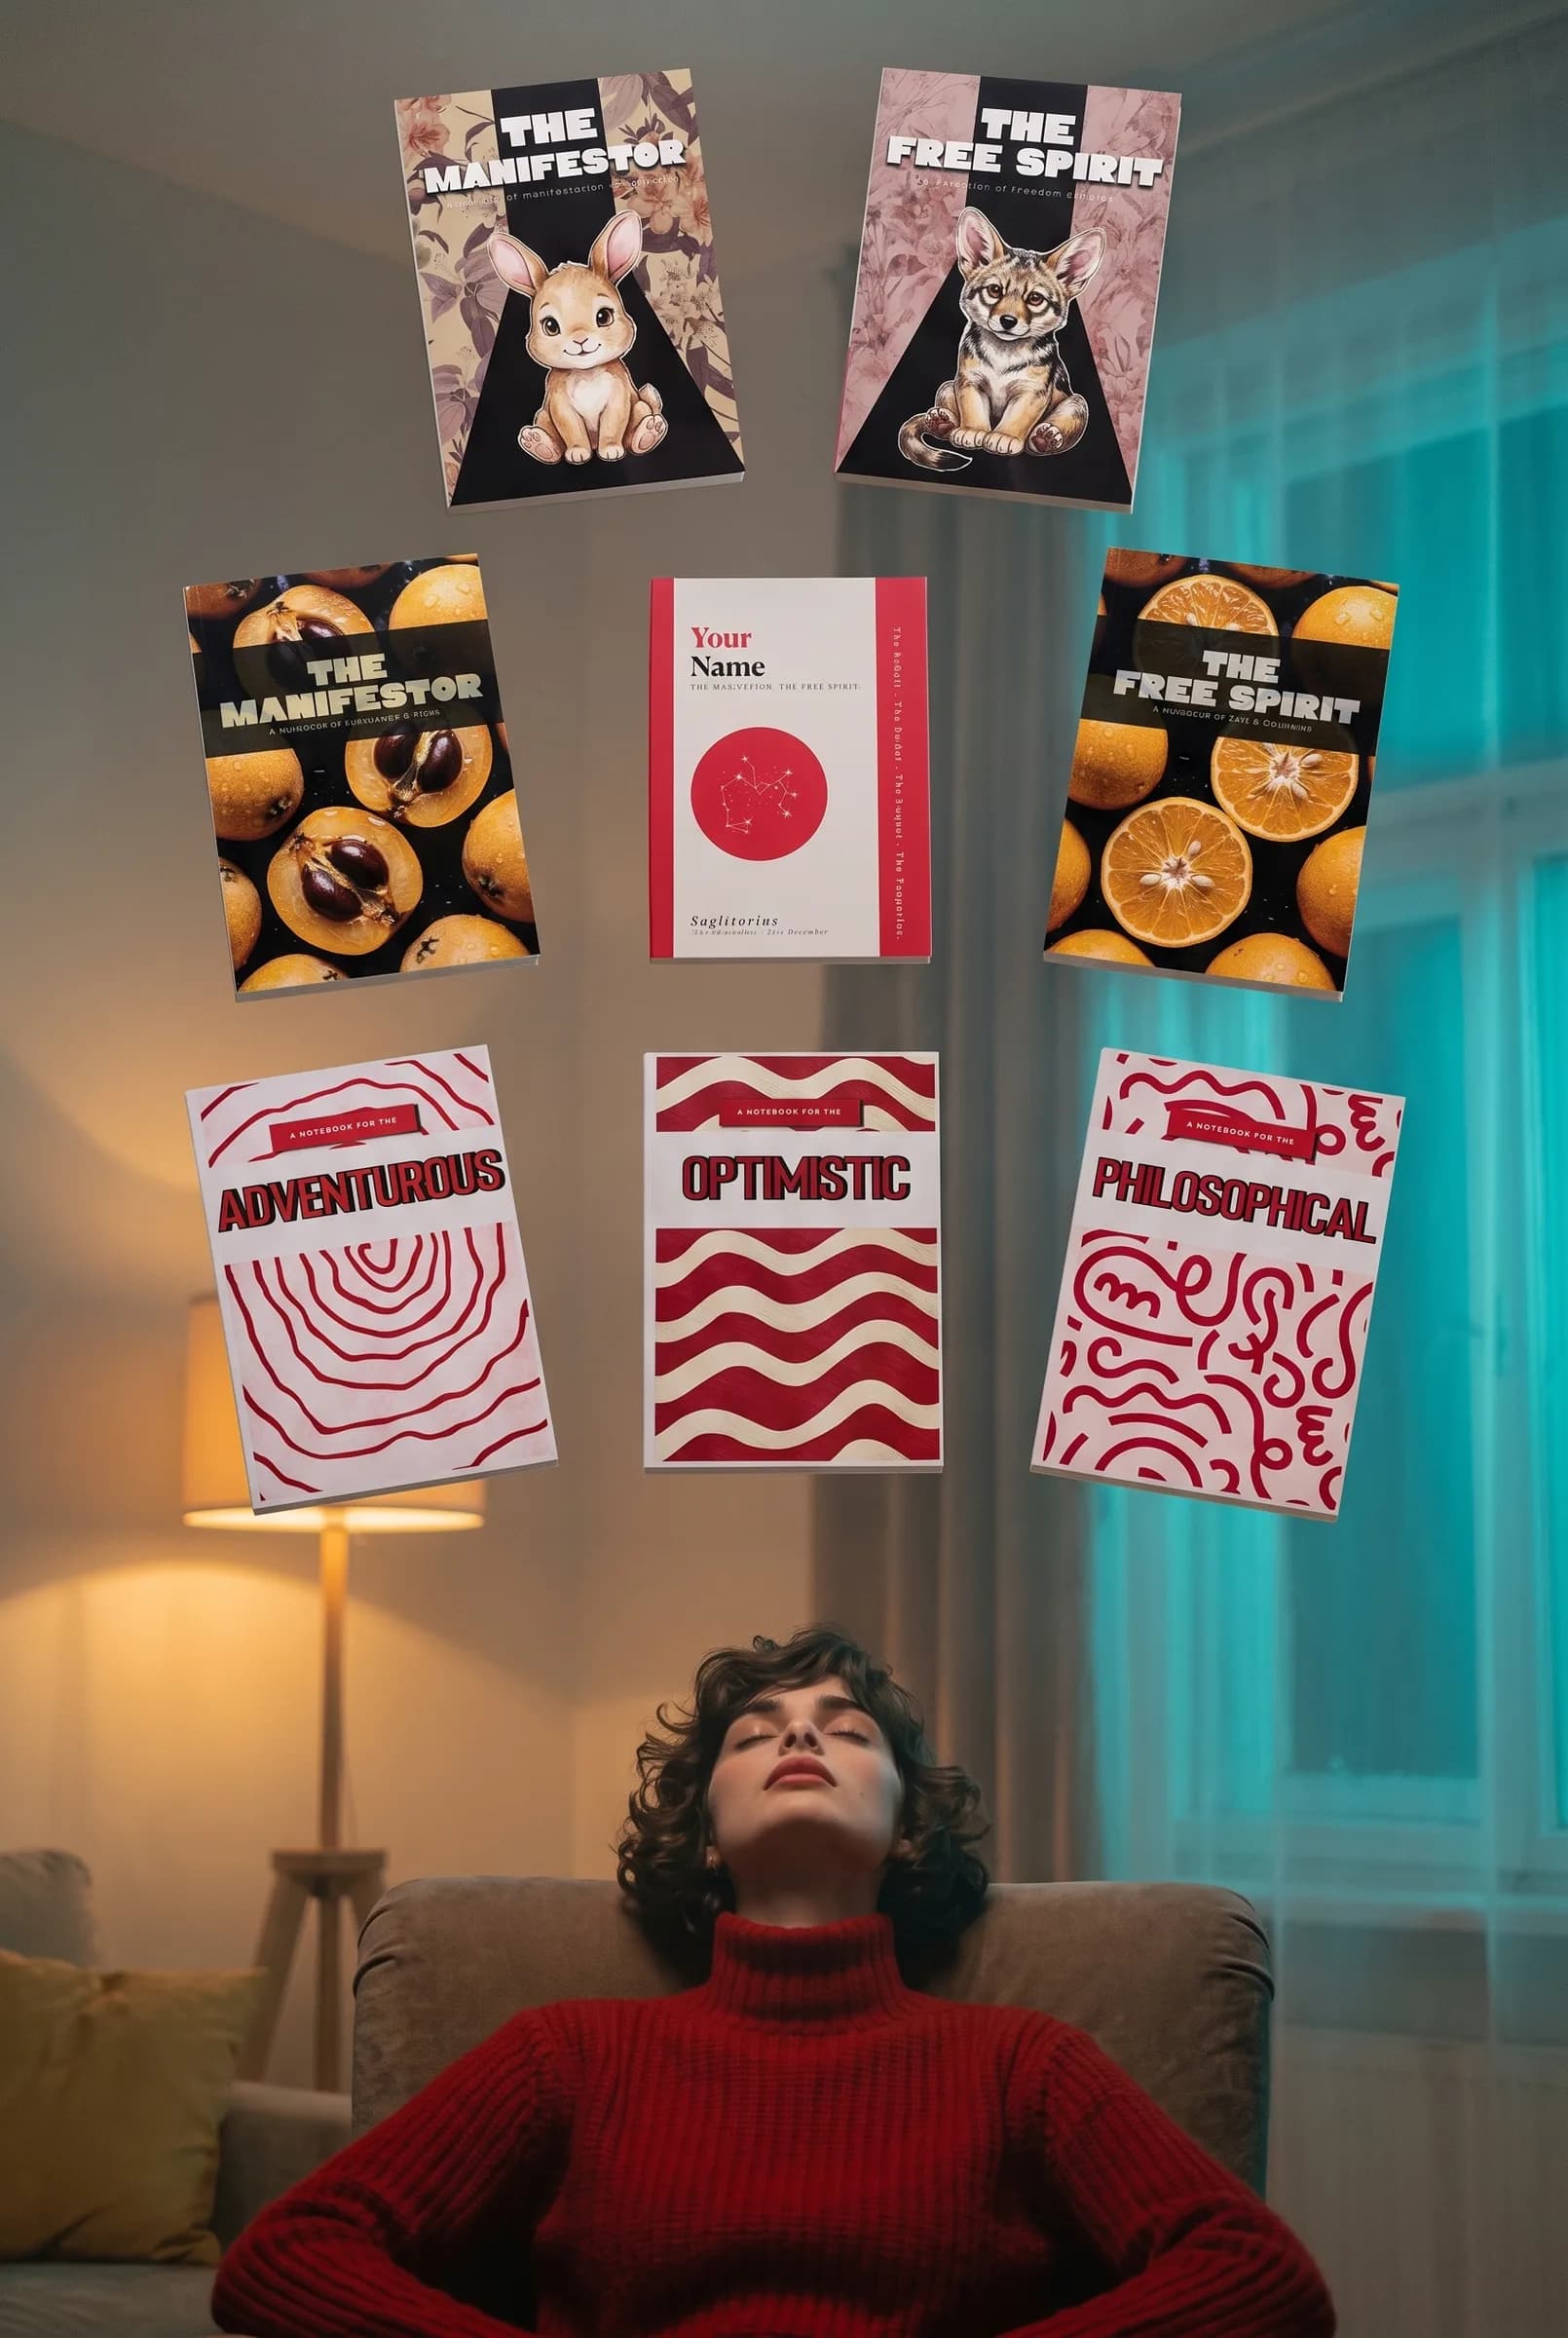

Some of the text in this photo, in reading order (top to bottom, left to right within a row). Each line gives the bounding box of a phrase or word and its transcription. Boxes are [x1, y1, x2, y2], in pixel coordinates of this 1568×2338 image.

[500, 107, 599, 147] THE
[981, 107, 1076, 145] THE
[423, 139, 687, 194] MANIFESTOR
[887, 135, 1164, 187] FREE SPIRIT
[691, 626, 752, 649] Your
[307, 653, 388, 687] THE
[691, 656, 765, 677] Name
[1203, 650, 1281, 684] THE
[219, 673, 484, 729] MANIFESTOR
[1113, 669, 1361, 725] FREE SPIRIT
[299, 1123, 354, 1138] NOTEBOOK
[356, 1120, 376, 1129] FOR
[379, 1116, 397, 1125] THE
[1196, 1122, 1251, 1138] NOTEBOOK
[1253, 1132, 1274, 1142] FOR
[1277, 1136, 1294, 1145] THE
[218, 1149, 505, 1233] ADVENTUROUS
[682, 1155, 911, 1201] OPTIMISTIC
[1092, 1156, 1377, 1245] PHILOSOPHICAL
